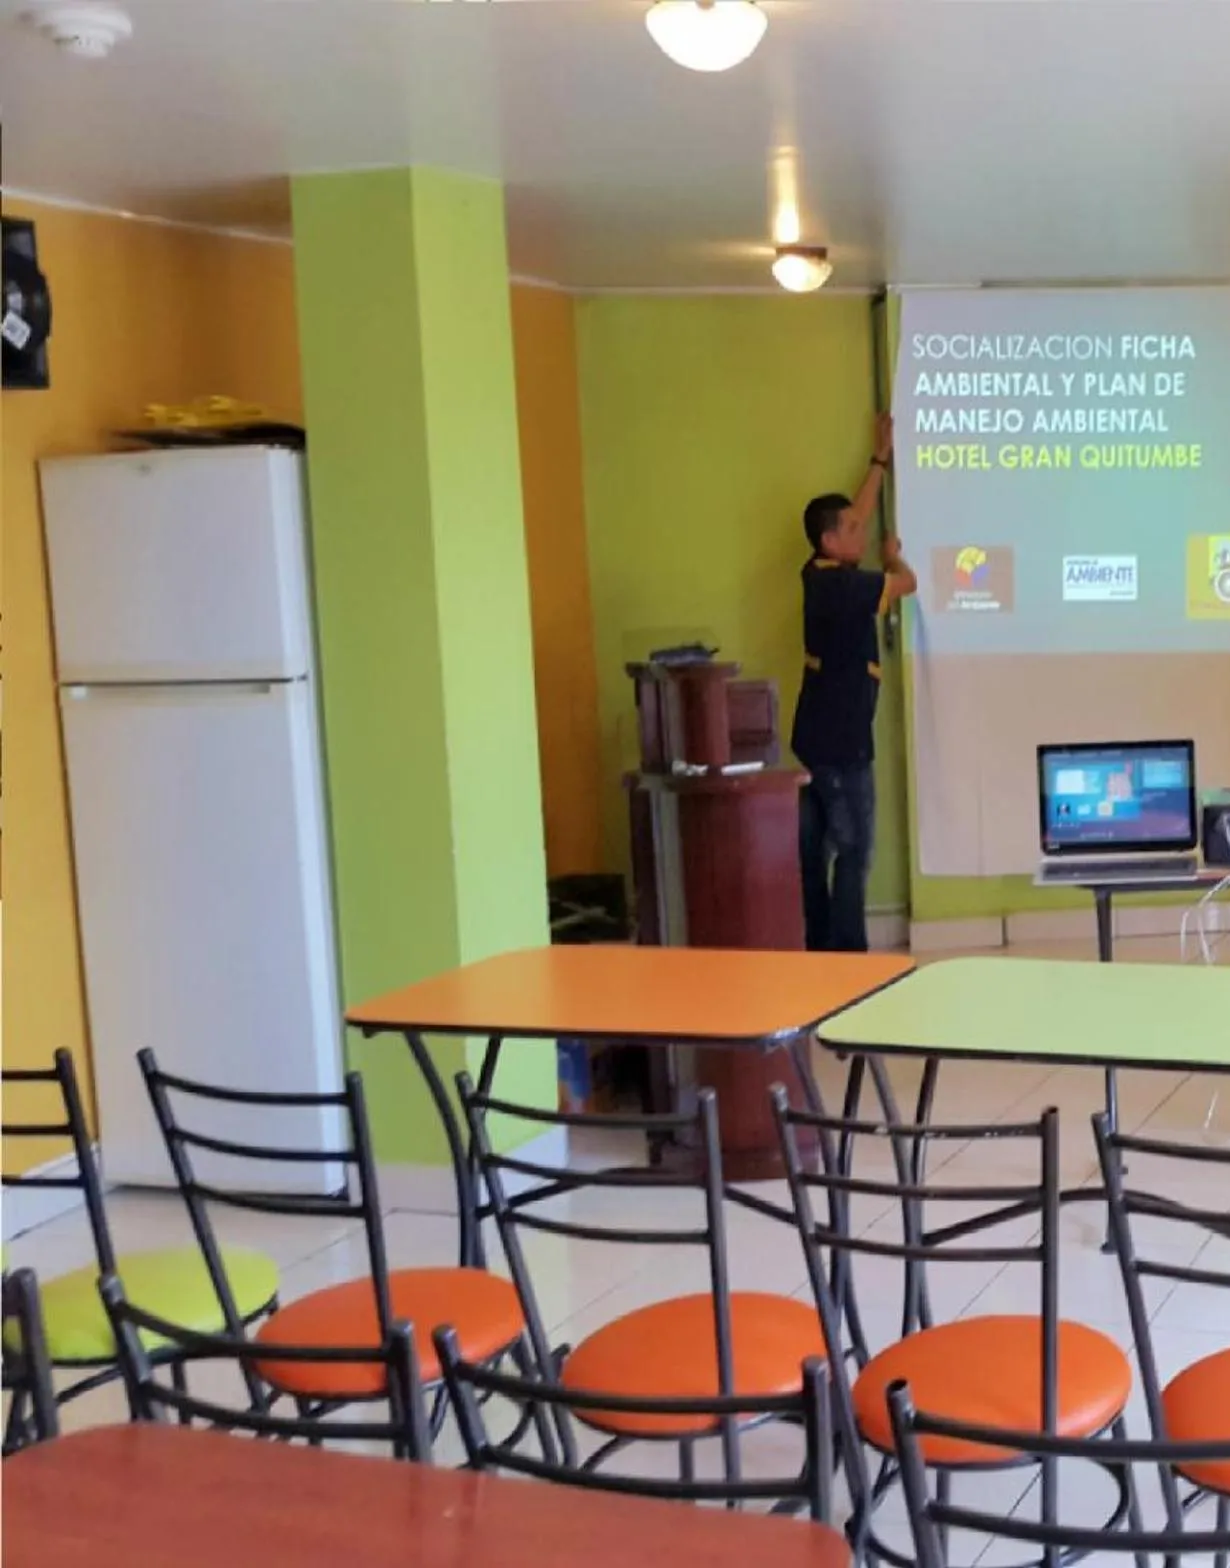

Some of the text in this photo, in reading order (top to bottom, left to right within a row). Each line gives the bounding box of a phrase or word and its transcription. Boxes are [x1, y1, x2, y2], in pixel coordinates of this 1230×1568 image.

[912, 334, 1196, 360] SOCIALIZACION FICHA
[914, 372, 1186, 396] AMBIENTAL Y PLAN DE
[915, 408, 1169, 433] MANEJO AMBIENTAL
[917, 444, 1202, 468] HOTEL GRAN QUITUMBE
